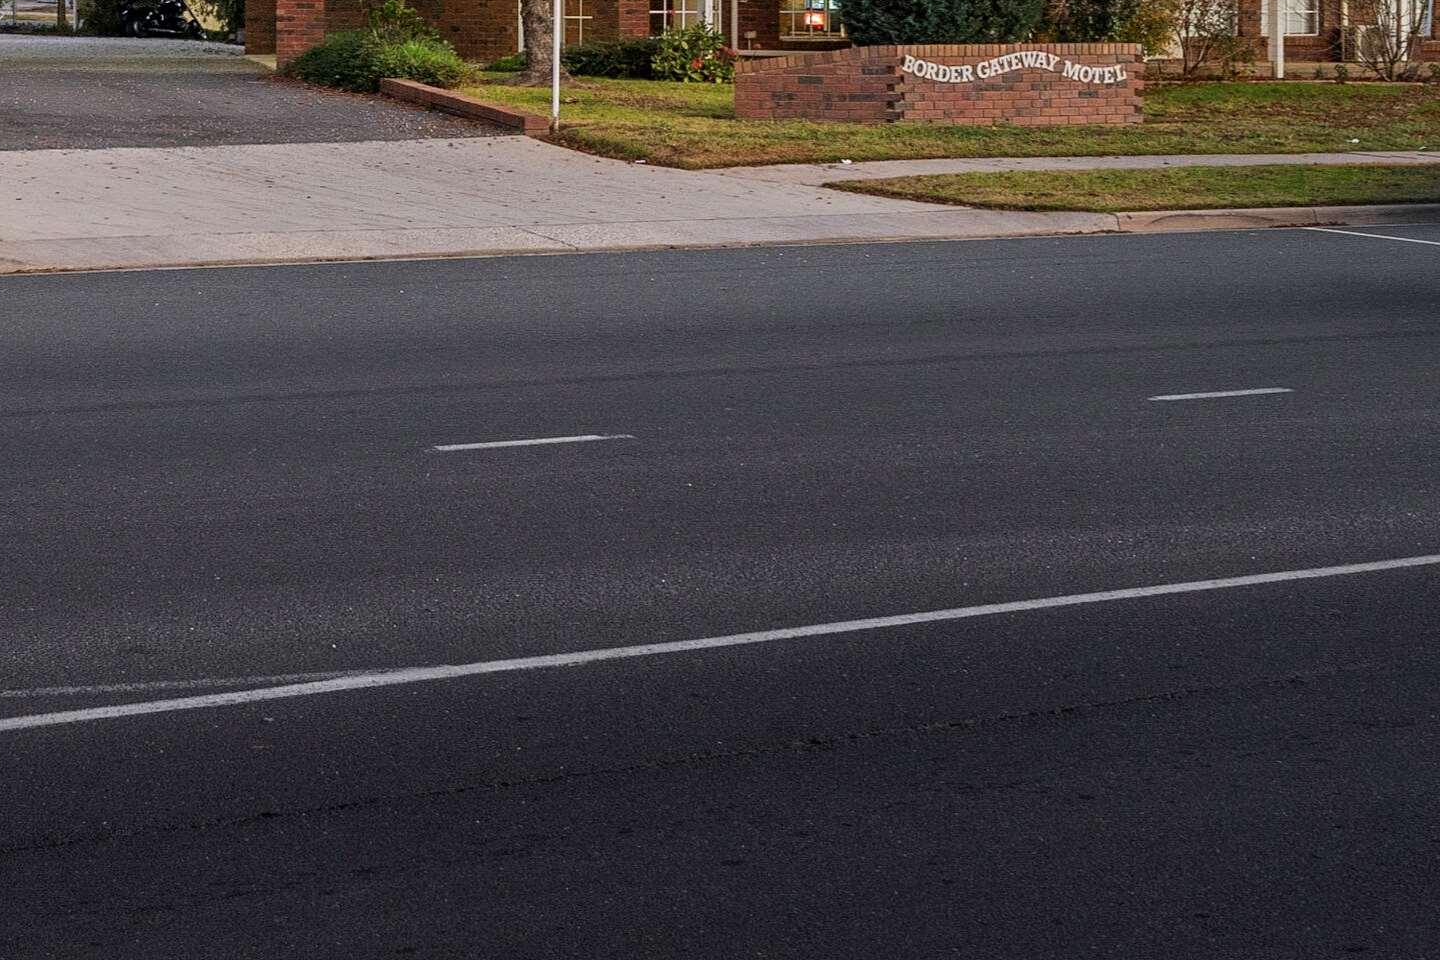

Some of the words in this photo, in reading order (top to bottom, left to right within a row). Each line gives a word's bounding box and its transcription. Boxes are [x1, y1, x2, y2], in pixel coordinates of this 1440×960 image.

[902, 54, 975, 83] BORDER
[976, 50, 1060, 79] GATEWAY
[1062, 60, 1128, 84] MOTEL
